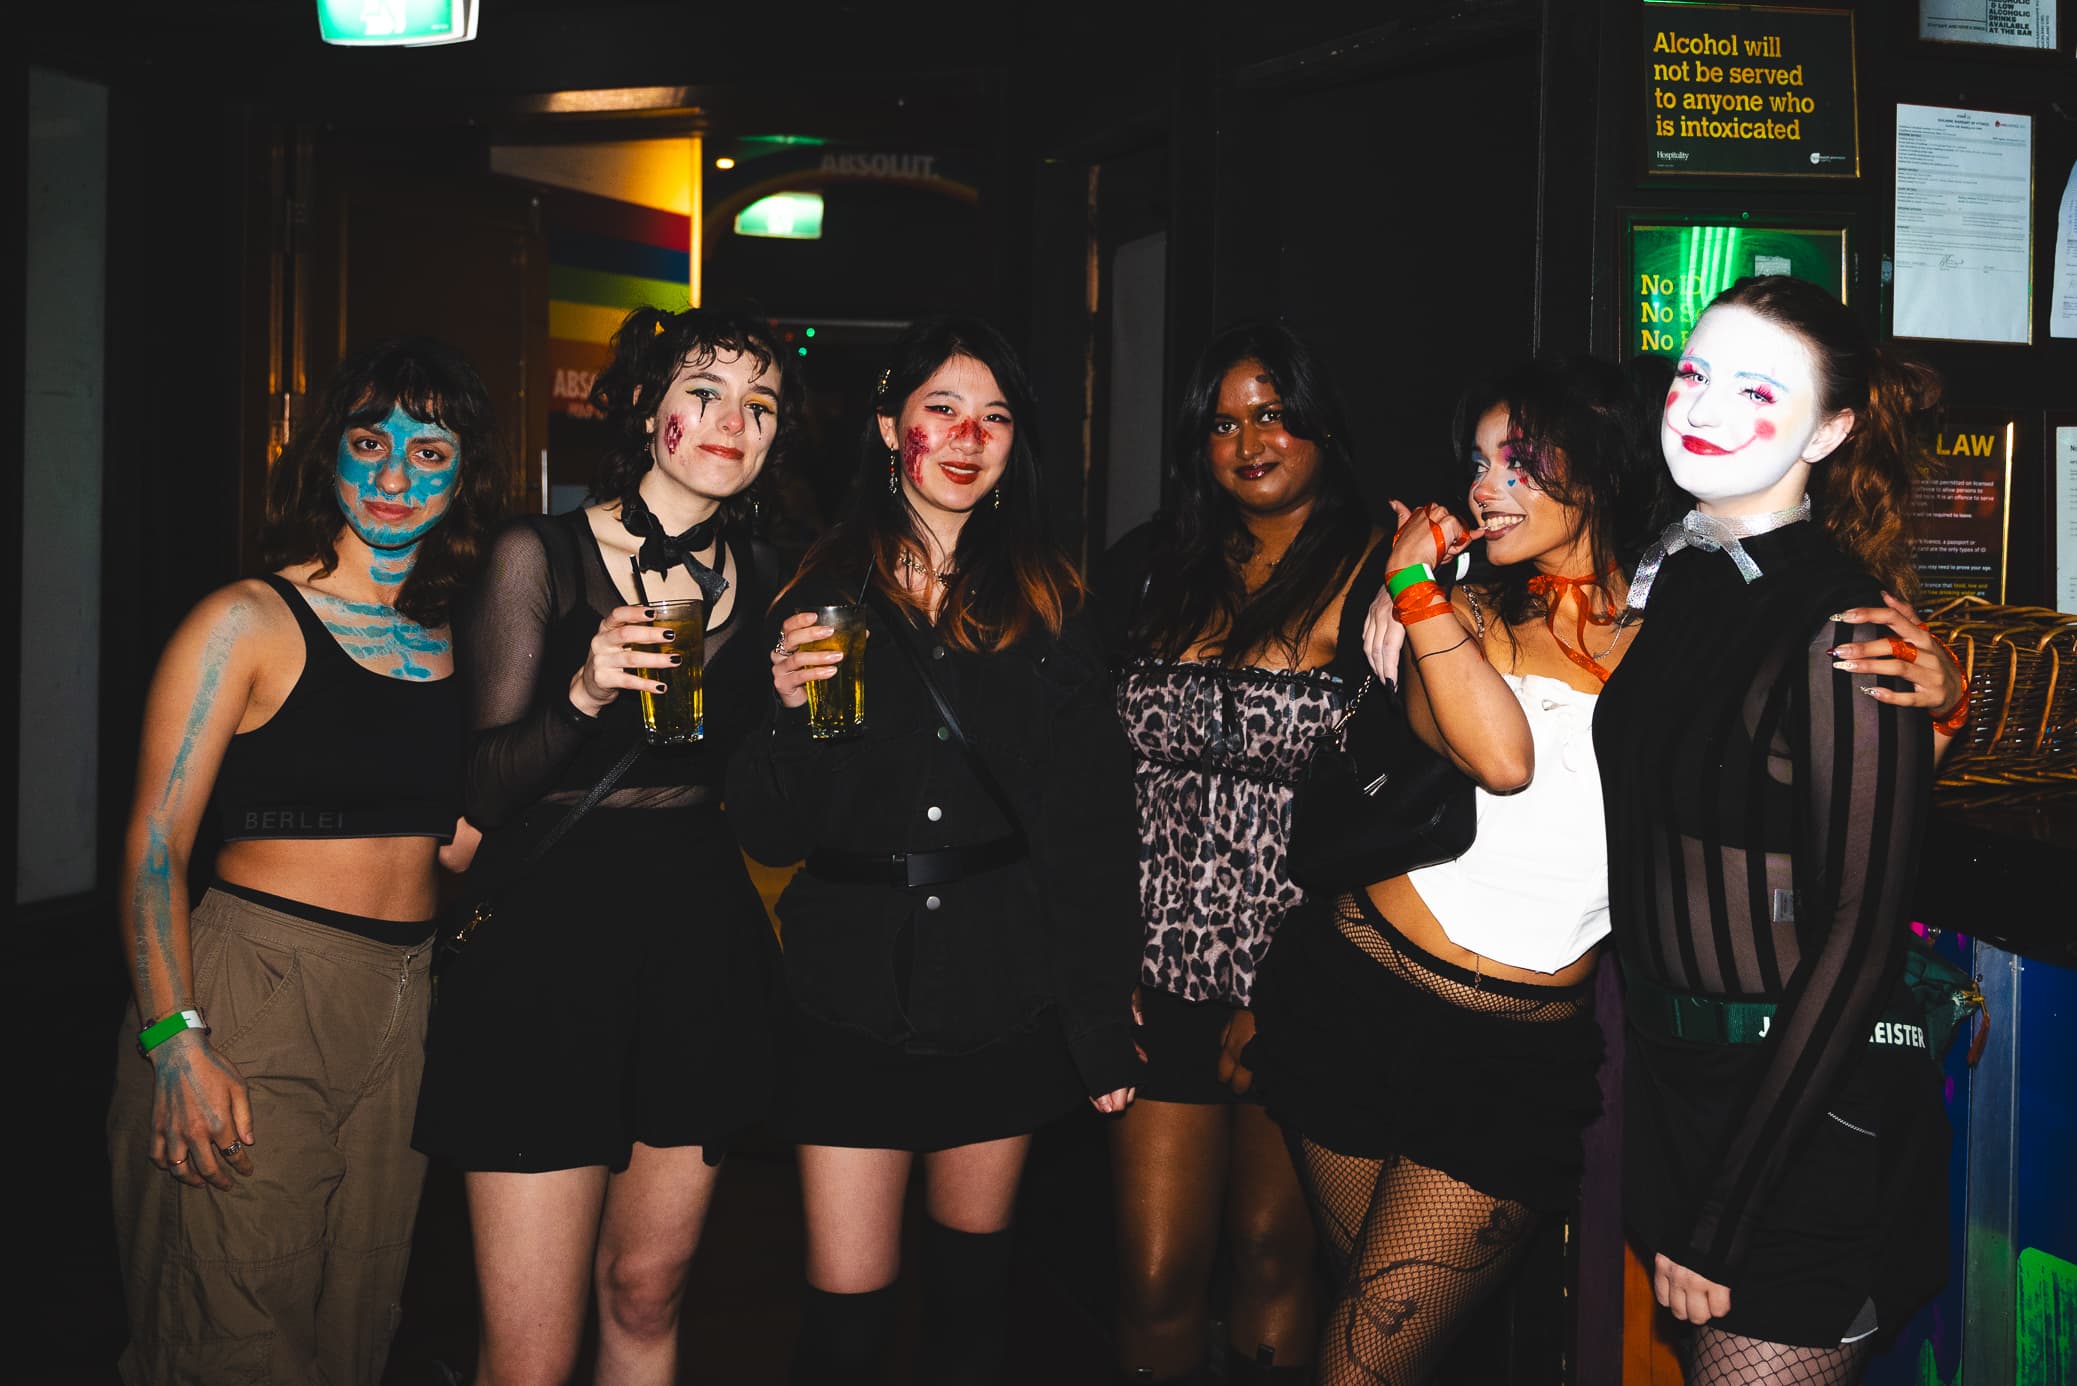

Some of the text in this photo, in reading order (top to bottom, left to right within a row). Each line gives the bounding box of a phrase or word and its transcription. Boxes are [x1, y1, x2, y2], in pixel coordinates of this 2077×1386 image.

[1989, 9, 2031, 17] ALCOHOLIC
[1989, 21, 2029, 29] AVAILABLE
[1652, 31, 1783, 58] Alcohol will
[1653, 60, 1804, 86] not be served
[1654, 87, 1816, 115] to anyone who
[1655, 114, 1801, 140] is intoxicated
[1656, 150, 1690, 161] Hospitality
[1640, 274, 1674, 295] No
[1640, 302, 1674, 323] No
[1640, 329, 1674, 351] No
[1936, 433, 1995, 457] LAW
[245, 811, 344, 830] BERLEI
